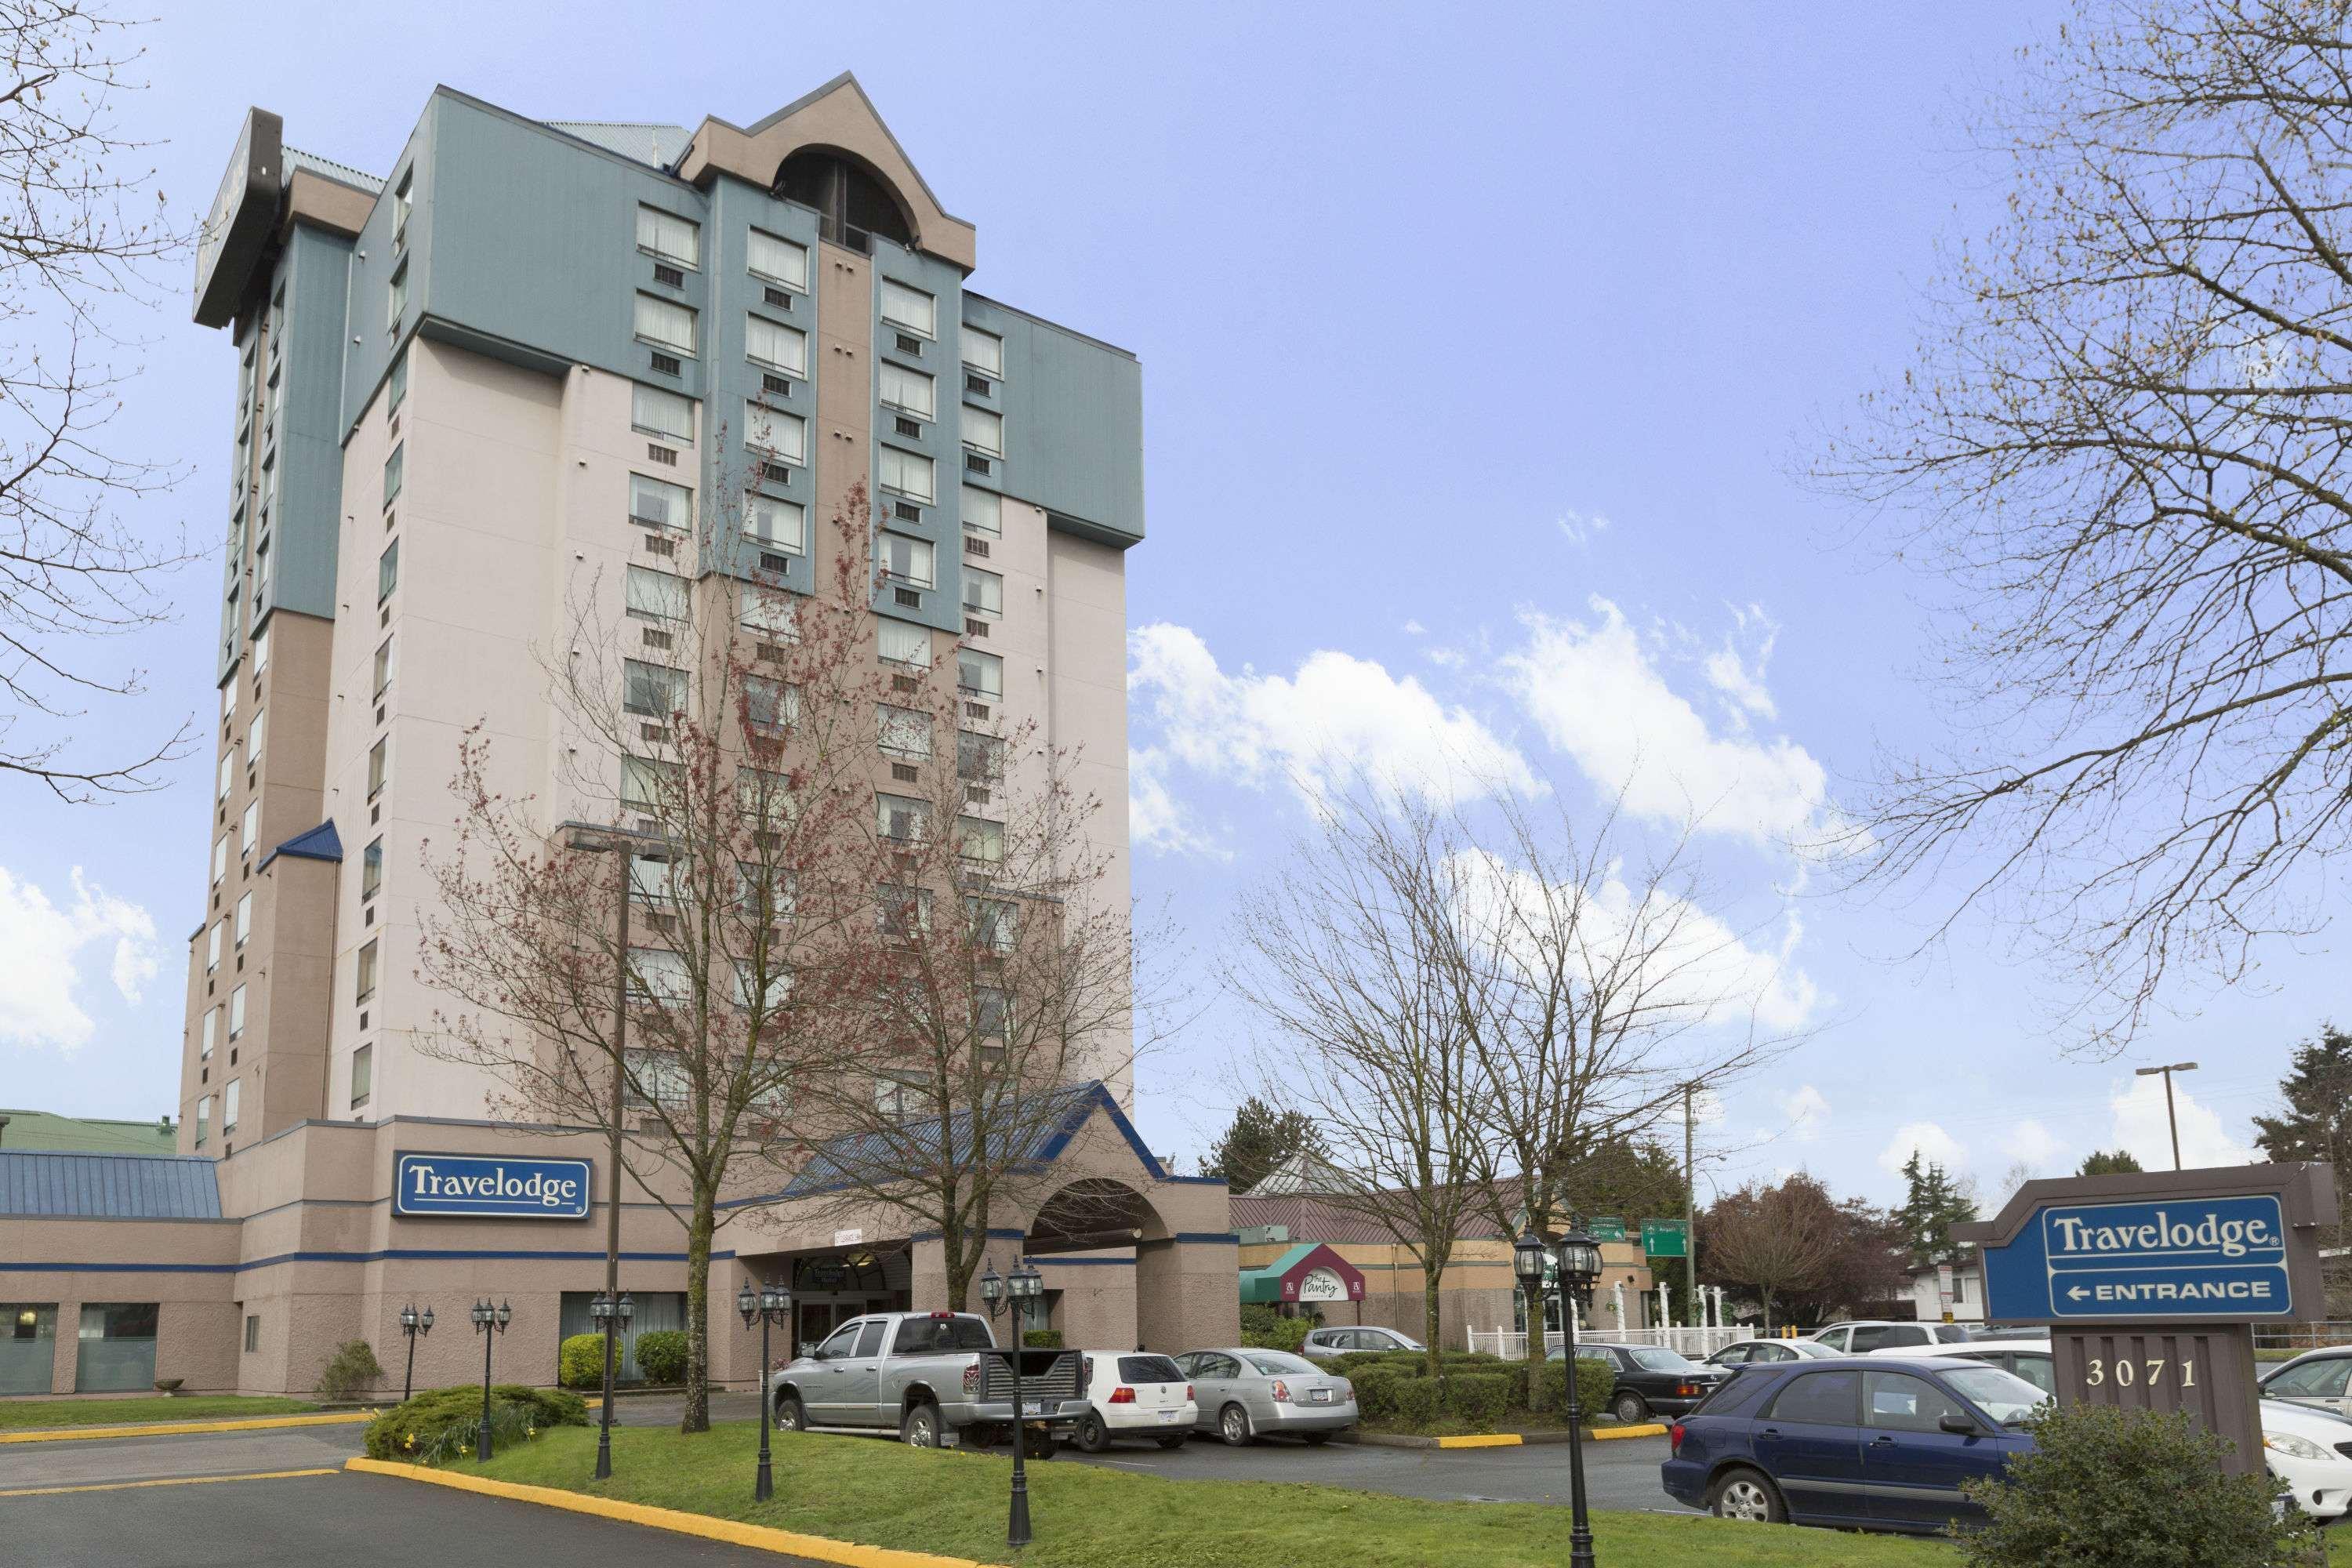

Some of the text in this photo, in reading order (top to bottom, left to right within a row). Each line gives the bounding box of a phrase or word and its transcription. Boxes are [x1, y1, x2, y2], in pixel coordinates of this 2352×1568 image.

[408, 1165, 577, 1207] Travelodge
[2053, 1211, 2269, 1257] Travelodge
[1304, 1274, 1338, 1298] Pantry
[2095, 1281, 2271, 1301] ENTRANCE
[2086, 1359, 2196, 1387] 3071
